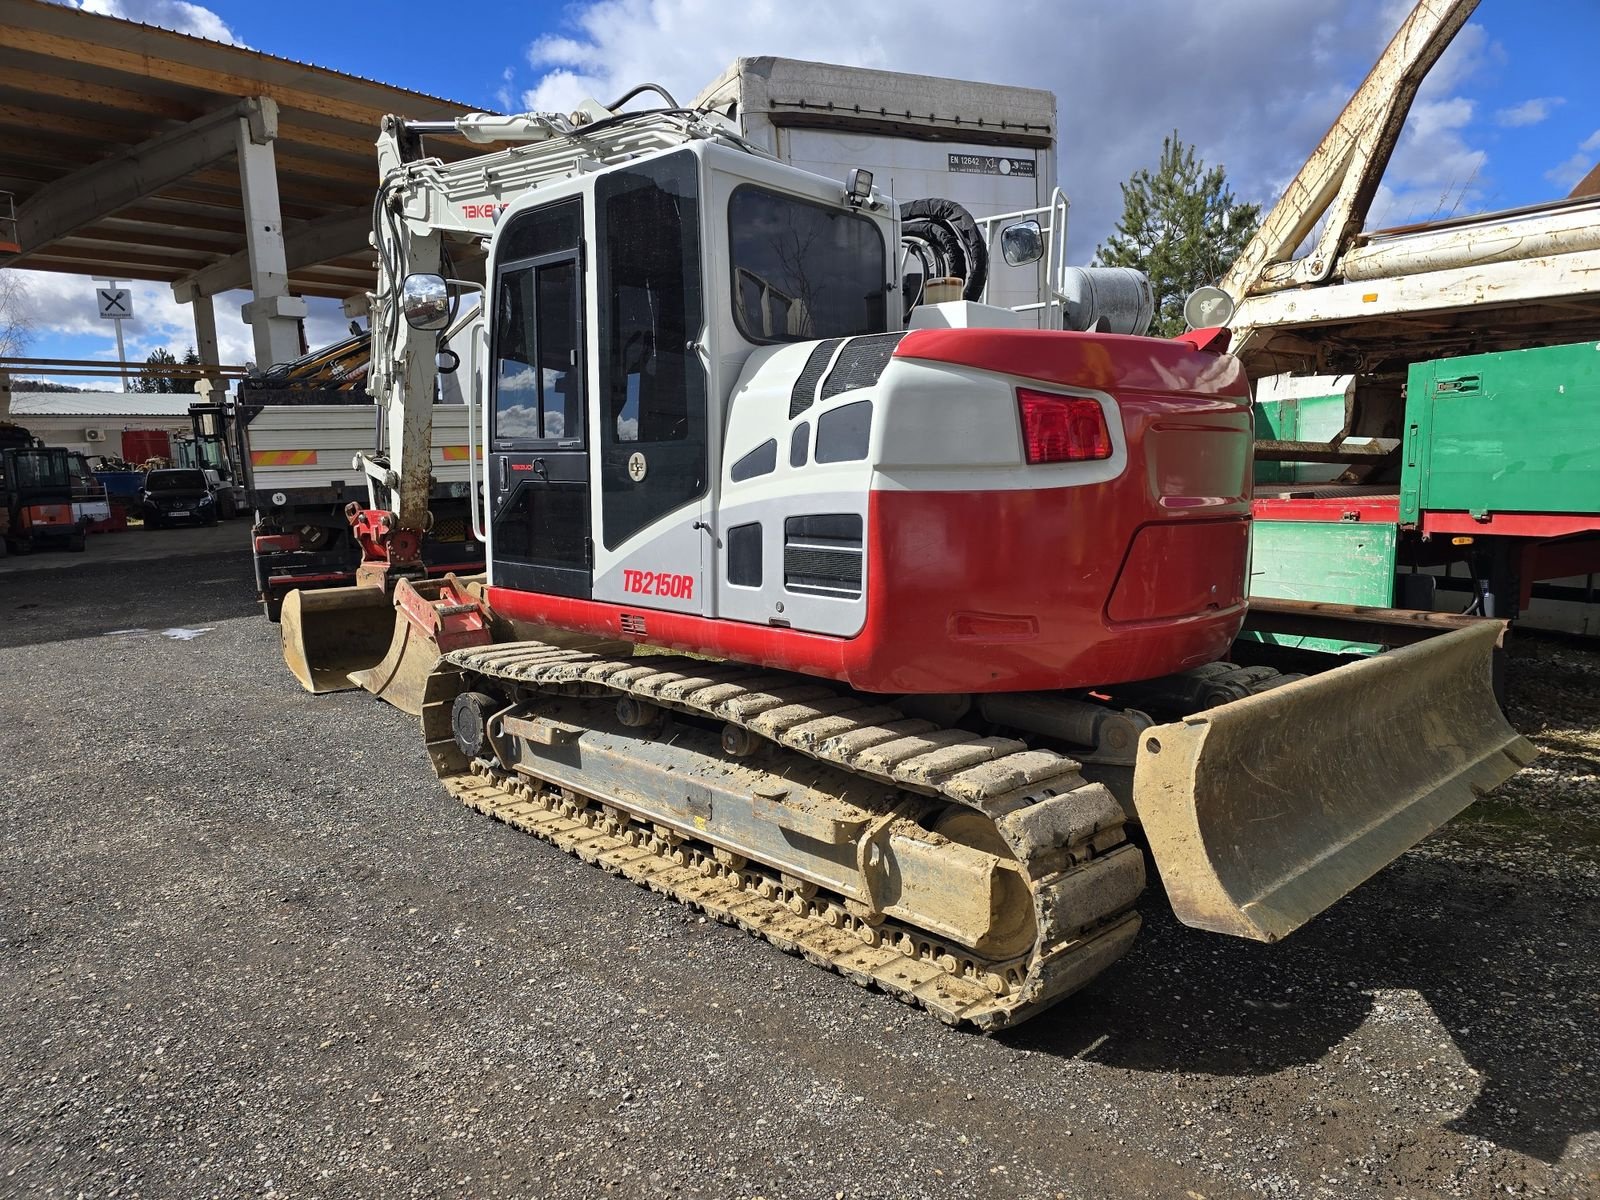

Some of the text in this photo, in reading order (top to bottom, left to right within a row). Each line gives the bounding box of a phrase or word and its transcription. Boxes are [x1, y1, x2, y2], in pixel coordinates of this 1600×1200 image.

[950, 156, 959, 164] EN
[960, 157, 980, 166] 12642
[623, 569, 694, 600] TB2150R
